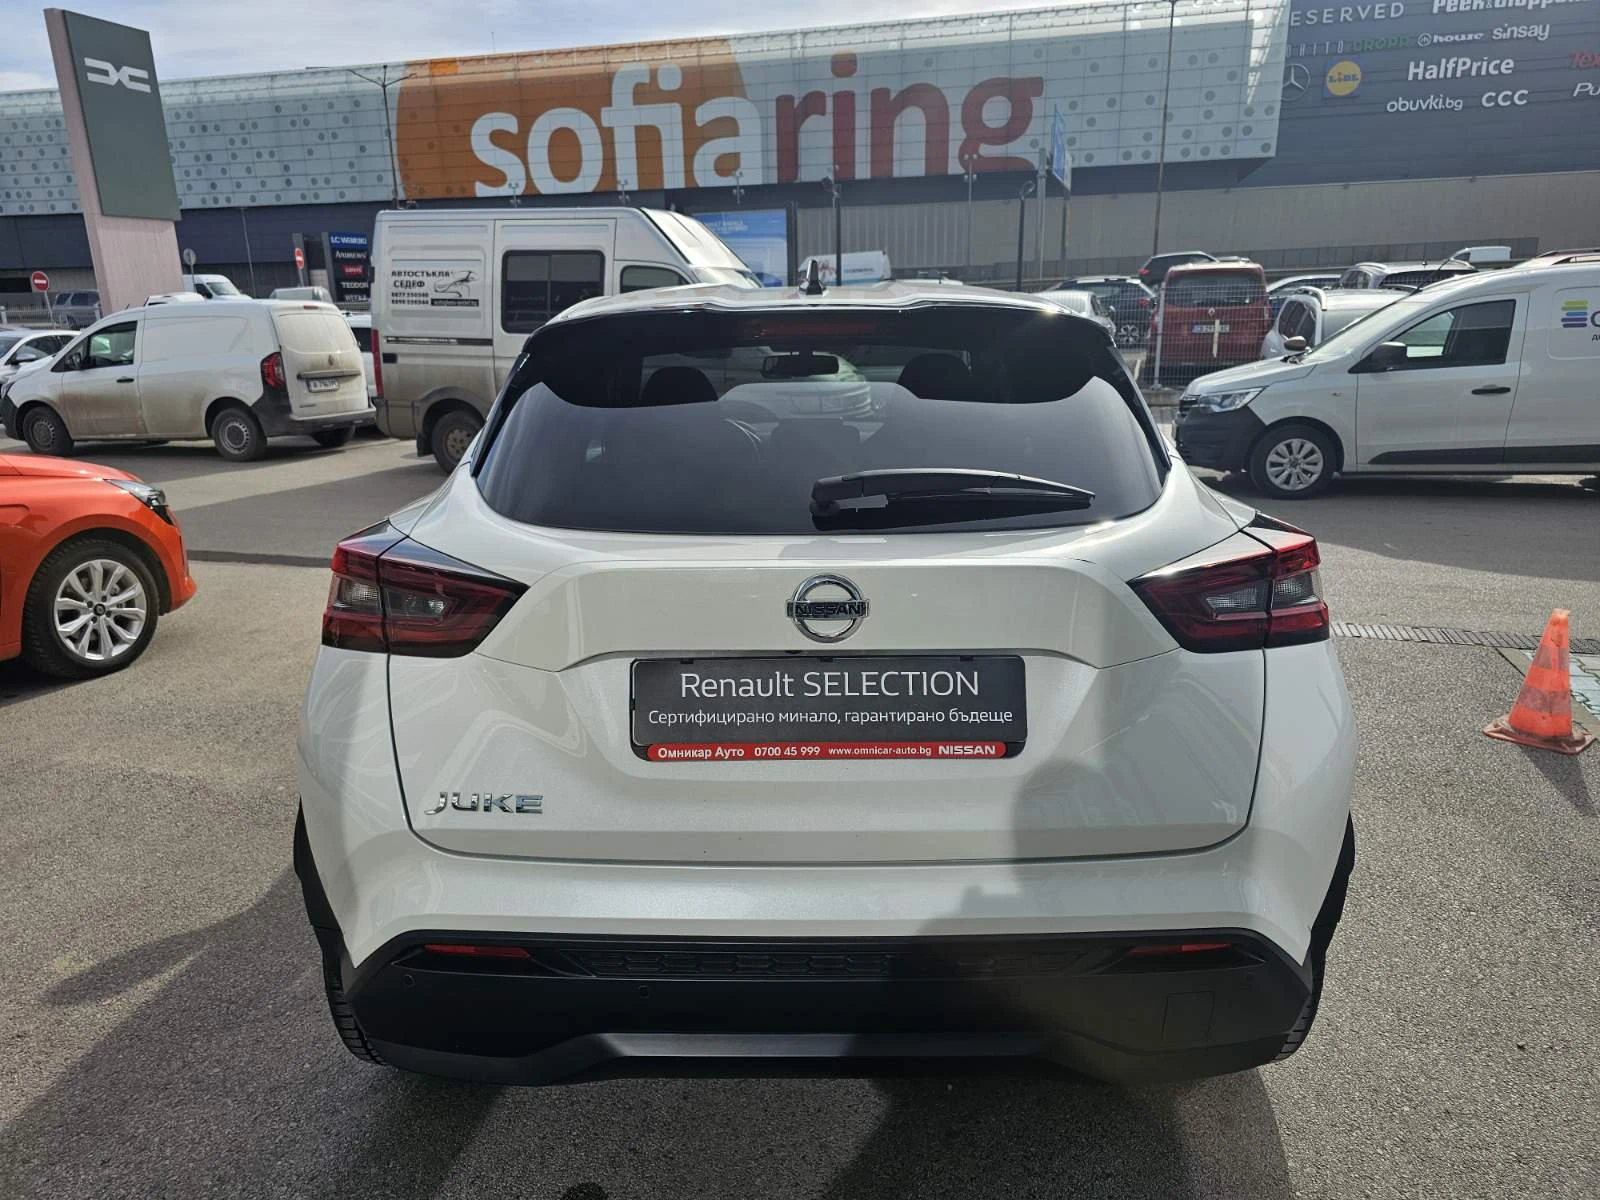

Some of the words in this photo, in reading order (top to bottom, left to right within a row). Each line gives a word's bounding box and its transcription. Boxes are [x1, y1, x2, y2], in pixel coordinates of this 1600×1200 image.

[1290, 2, 1405, 26] ESERVED
[1492, 24, 1550, 41] sinsay
[1407, 57, 1515, 81] HalfPrice
[1386, 95, 1464, 112] obuvki.bg
[1481, 90, 1529, 107] CCC
[794, 602, 863, 617] NISSAN
[680, 671, 795, 698] Renault
[803, 671, 979, 697] SELECTION
[648, 709, 775, 727] Сертифицирано
[778, 711, 841, 725] минало,
[845, 711, 945, 725] гарантирано
[949, 707, 1013, 724] бъдеще
[657, 748, 712, 759] Омникар
[715, 747, 745, 759] Ауто
[754, 747, 781, 756] 0700
[784, 747, 798, 756] 45
[800, 746, 821, 756] 999
[828, 745, 932, 756] www.omnicar-auto.bg
[938, 745, 996, 755] NISSAN
[423, 791, 544, 816] JUKE
